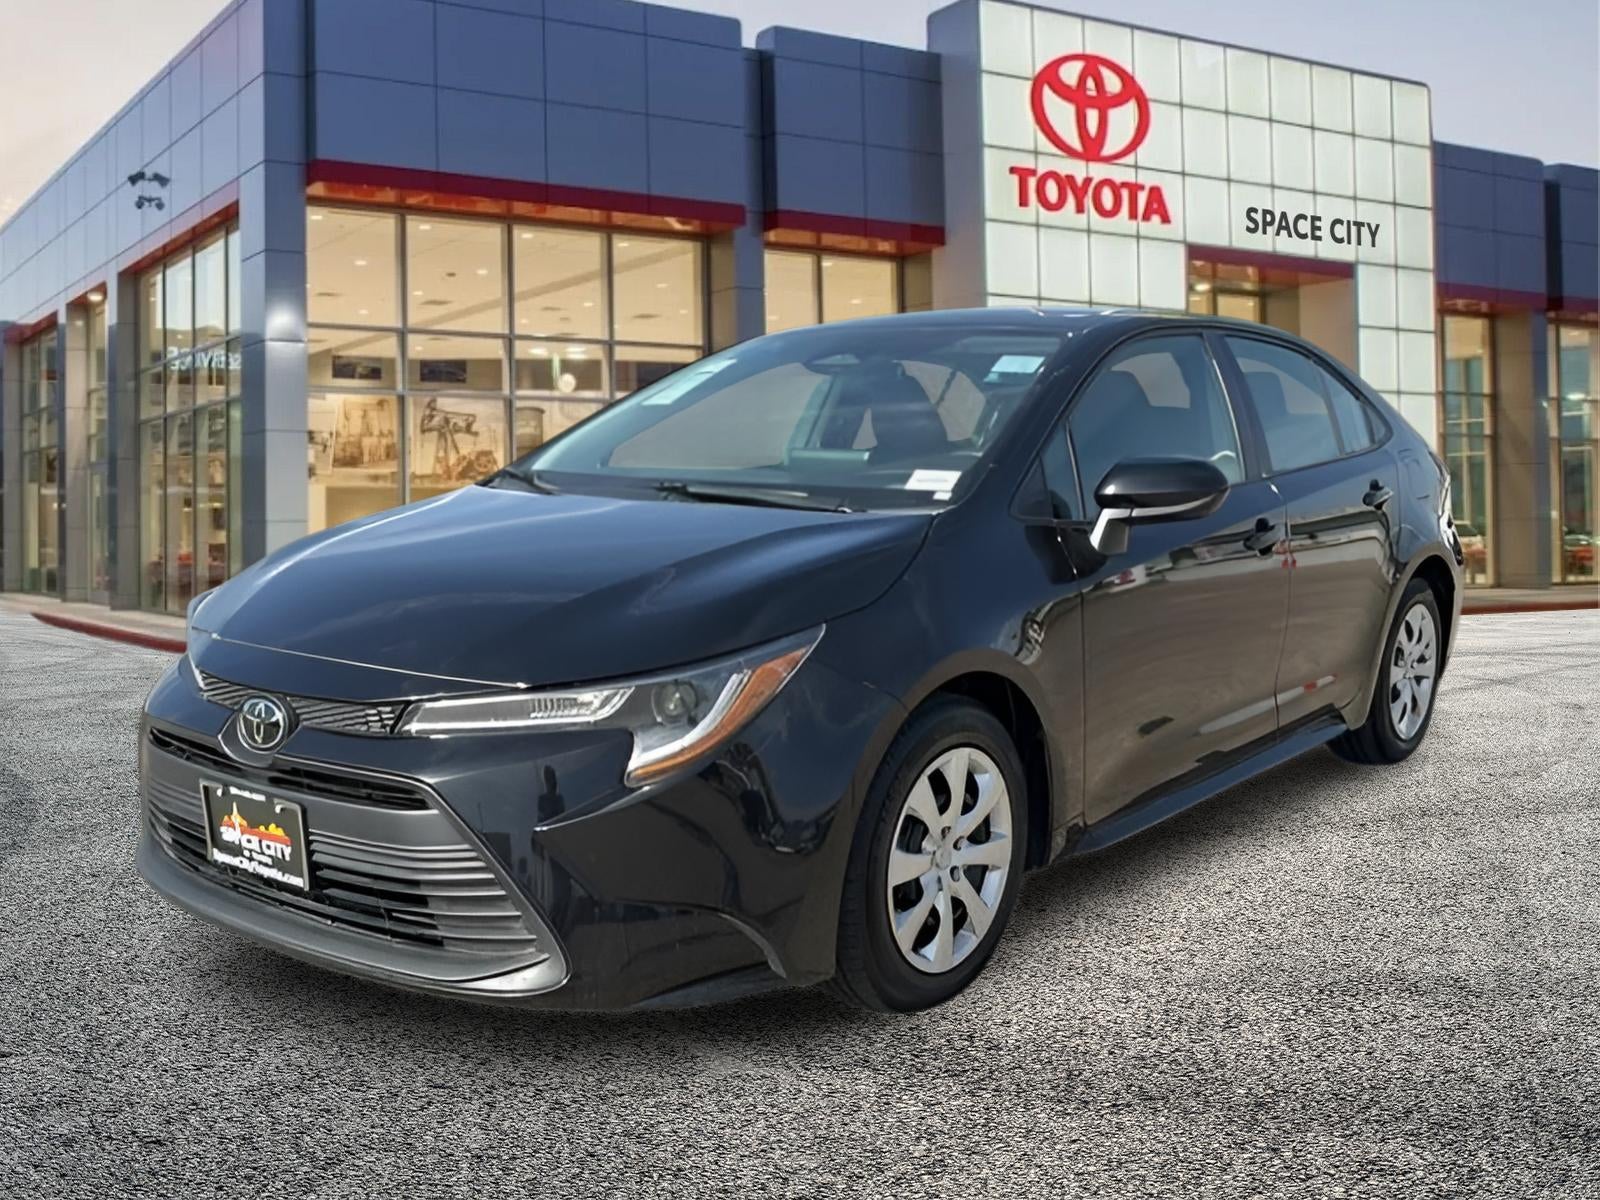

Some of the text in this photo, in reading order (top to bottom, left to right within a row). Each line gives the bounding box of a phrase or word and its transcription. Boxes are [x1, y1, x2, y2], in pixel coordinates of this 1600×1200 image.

[1009, 166, 1171, 224] TOYOTA
[1244, 206, 1381, 248] SPACE CITY
